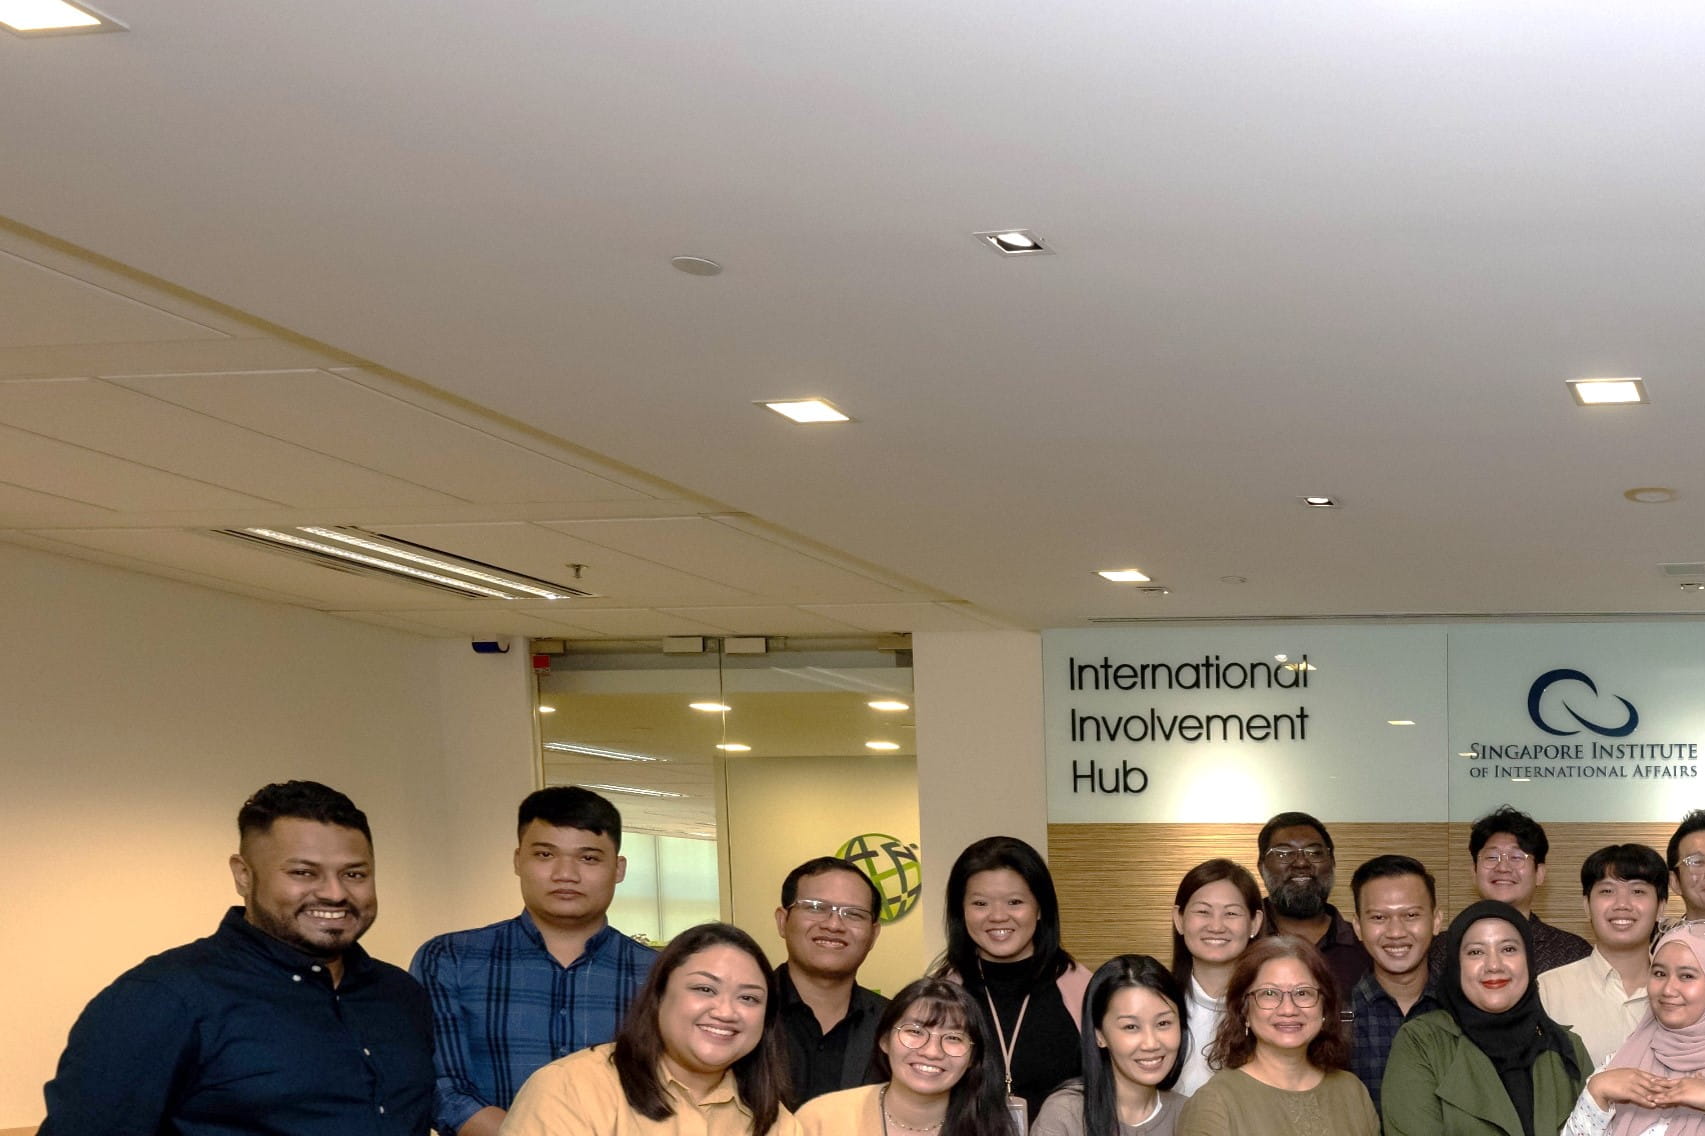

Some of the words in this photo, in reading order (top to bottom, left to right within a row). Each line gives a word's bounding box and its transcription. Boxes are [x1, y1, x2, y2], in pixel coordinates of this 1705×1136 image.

[1069, 654, 1309, 691] International
[1071, 706, 1309, 742] Involvement
[1469, 742, 1584, 760] SINGAPORE
[1592, 741, 1698, 760] INSTITUTE
[1072, 759, 1149, 794] Hub
[1469, 766, 1489, 778] OF
[1494, 765, 1628, 778] INTERNATIONAL
[1632, 764, 1698, 778] AFFAIRS
